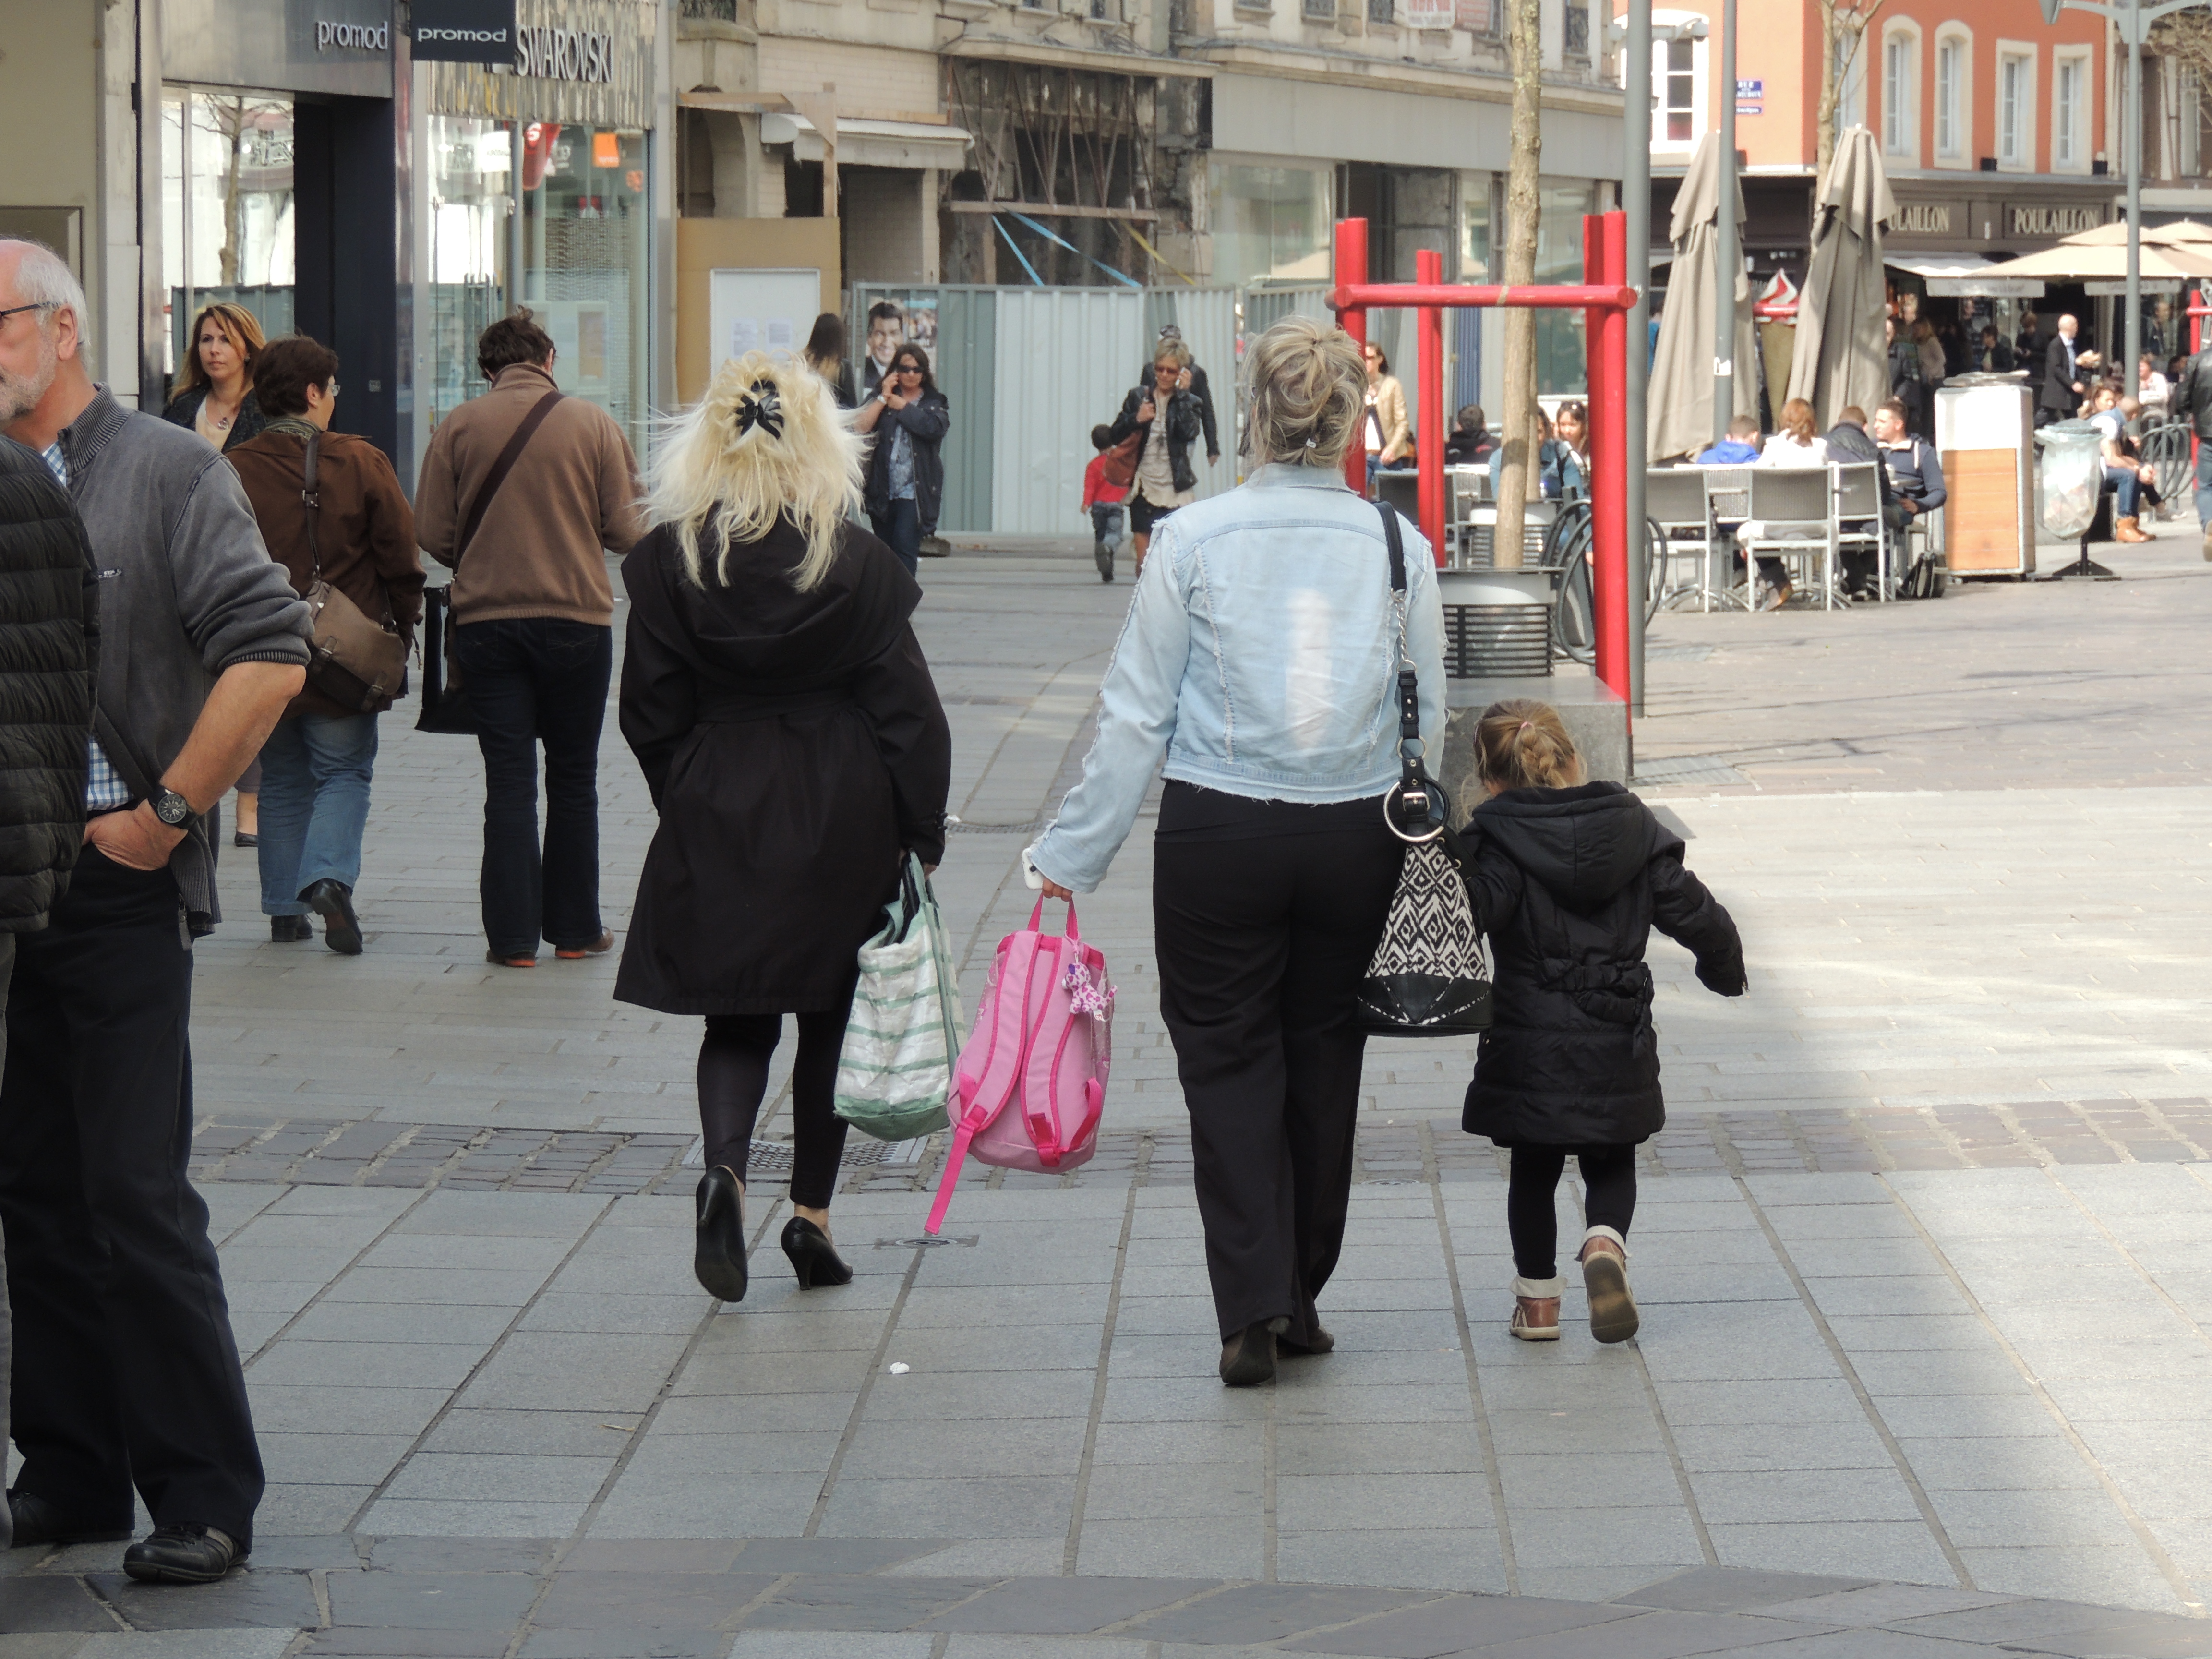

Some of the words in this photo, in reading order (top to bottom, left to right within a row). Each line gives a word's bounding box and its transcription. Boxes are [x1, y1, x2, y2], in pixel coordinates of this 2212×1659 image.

[319, 21, 388, 50] promod
[418, 27, 507, 42] promod
[516, 24, 613, 83] SWAROVSKI
[1889, 206, 1949, 232] ULAILLON
[2014, 208, 2099, 234] POULAILLON
